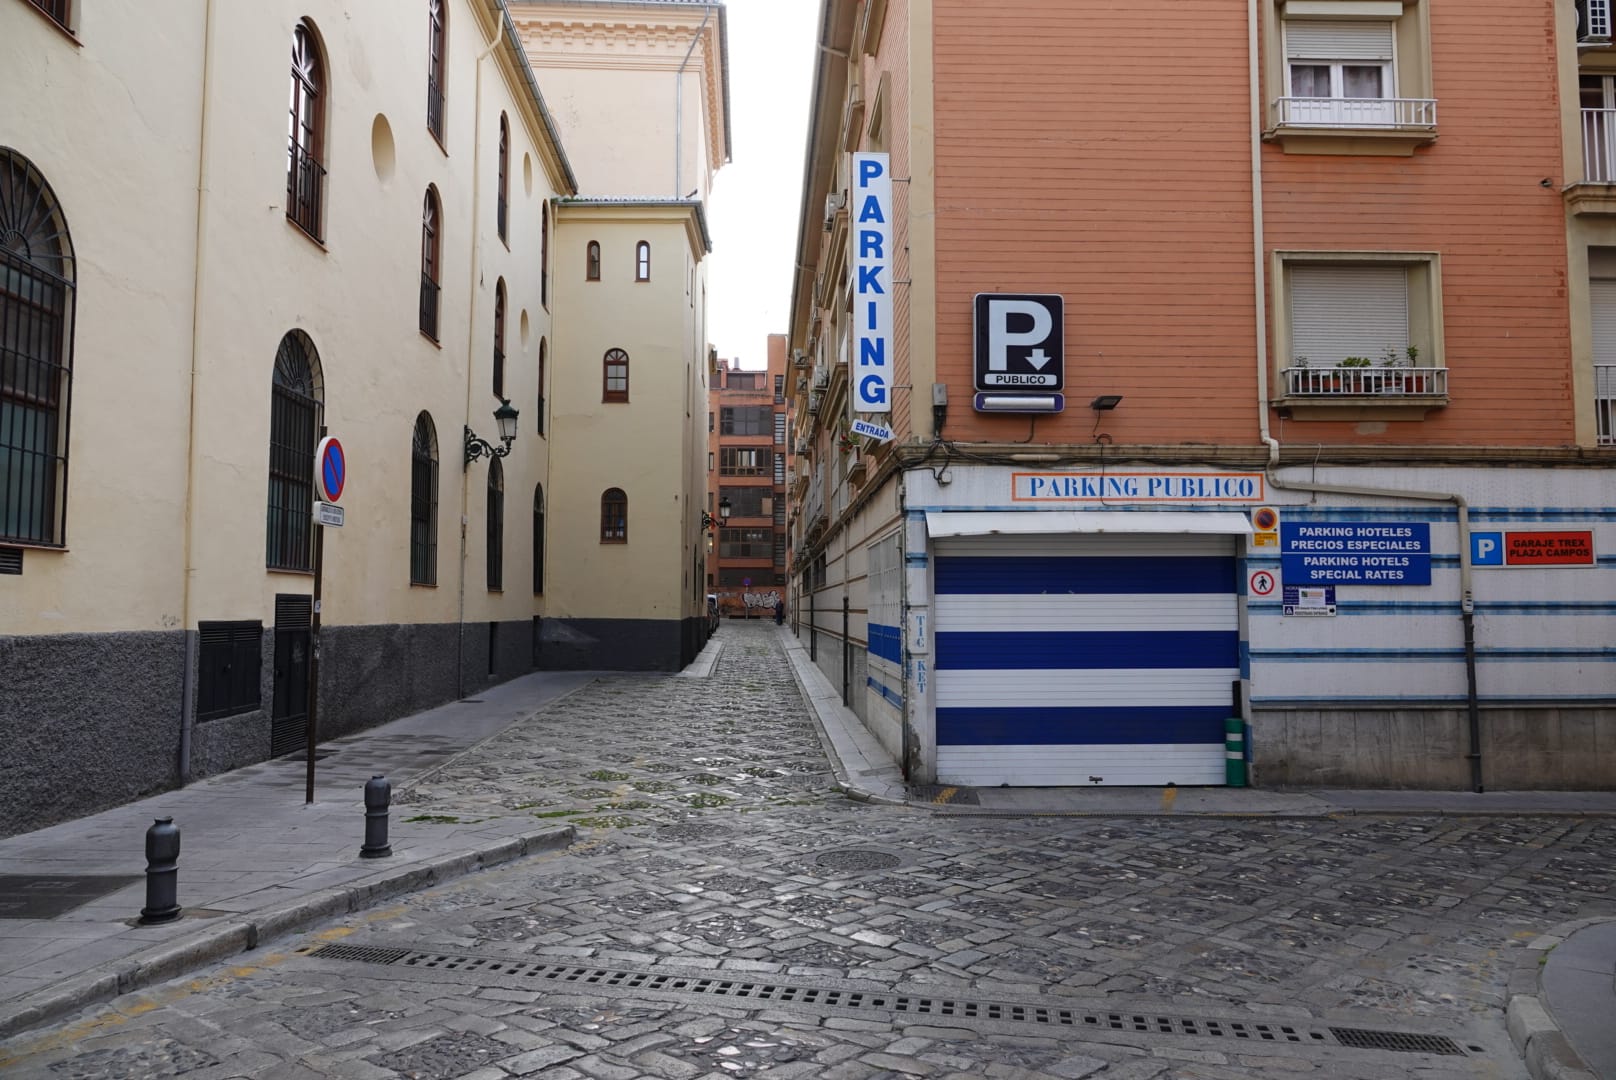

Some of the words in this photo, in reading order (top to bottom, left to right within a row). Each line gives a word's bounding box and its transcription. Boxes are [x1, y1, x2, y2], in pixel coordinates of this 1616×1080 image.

[858, 160, 886, 404] PARKING
[988, 299, 1053, 371] P
[995, 375, 1046, 385] PUBLICO
[855, 422, 889, 439] ENTRADA
[1029, 477, 1138, 497] PARKING
[1147, 477, 1254, 497] PUBLICO
[1299, 527, 1353, 537] PARKING
[1357, 527, 1412, 537] HOTELES
[1291, 540, 1344, 550] PRECIOS
[1347, 540, 1421, 550] ESPECIALES
[1478, 538, 1495, 559] P
[1513, 539, 1554, 548] GARAJE
[1558, 539, 1585, 547] TREX
[1509, 549, 1542, 557] PLAZA
[1546, 548, 1589, 557] CAMPOS
[1304, 557, 1358, 566] PARKING
[1362, 557, 1410, 566] HOTELS
[1310, 569, 1361, 579] SPECIAL
[1365, 570, 1404, 579] RATES
